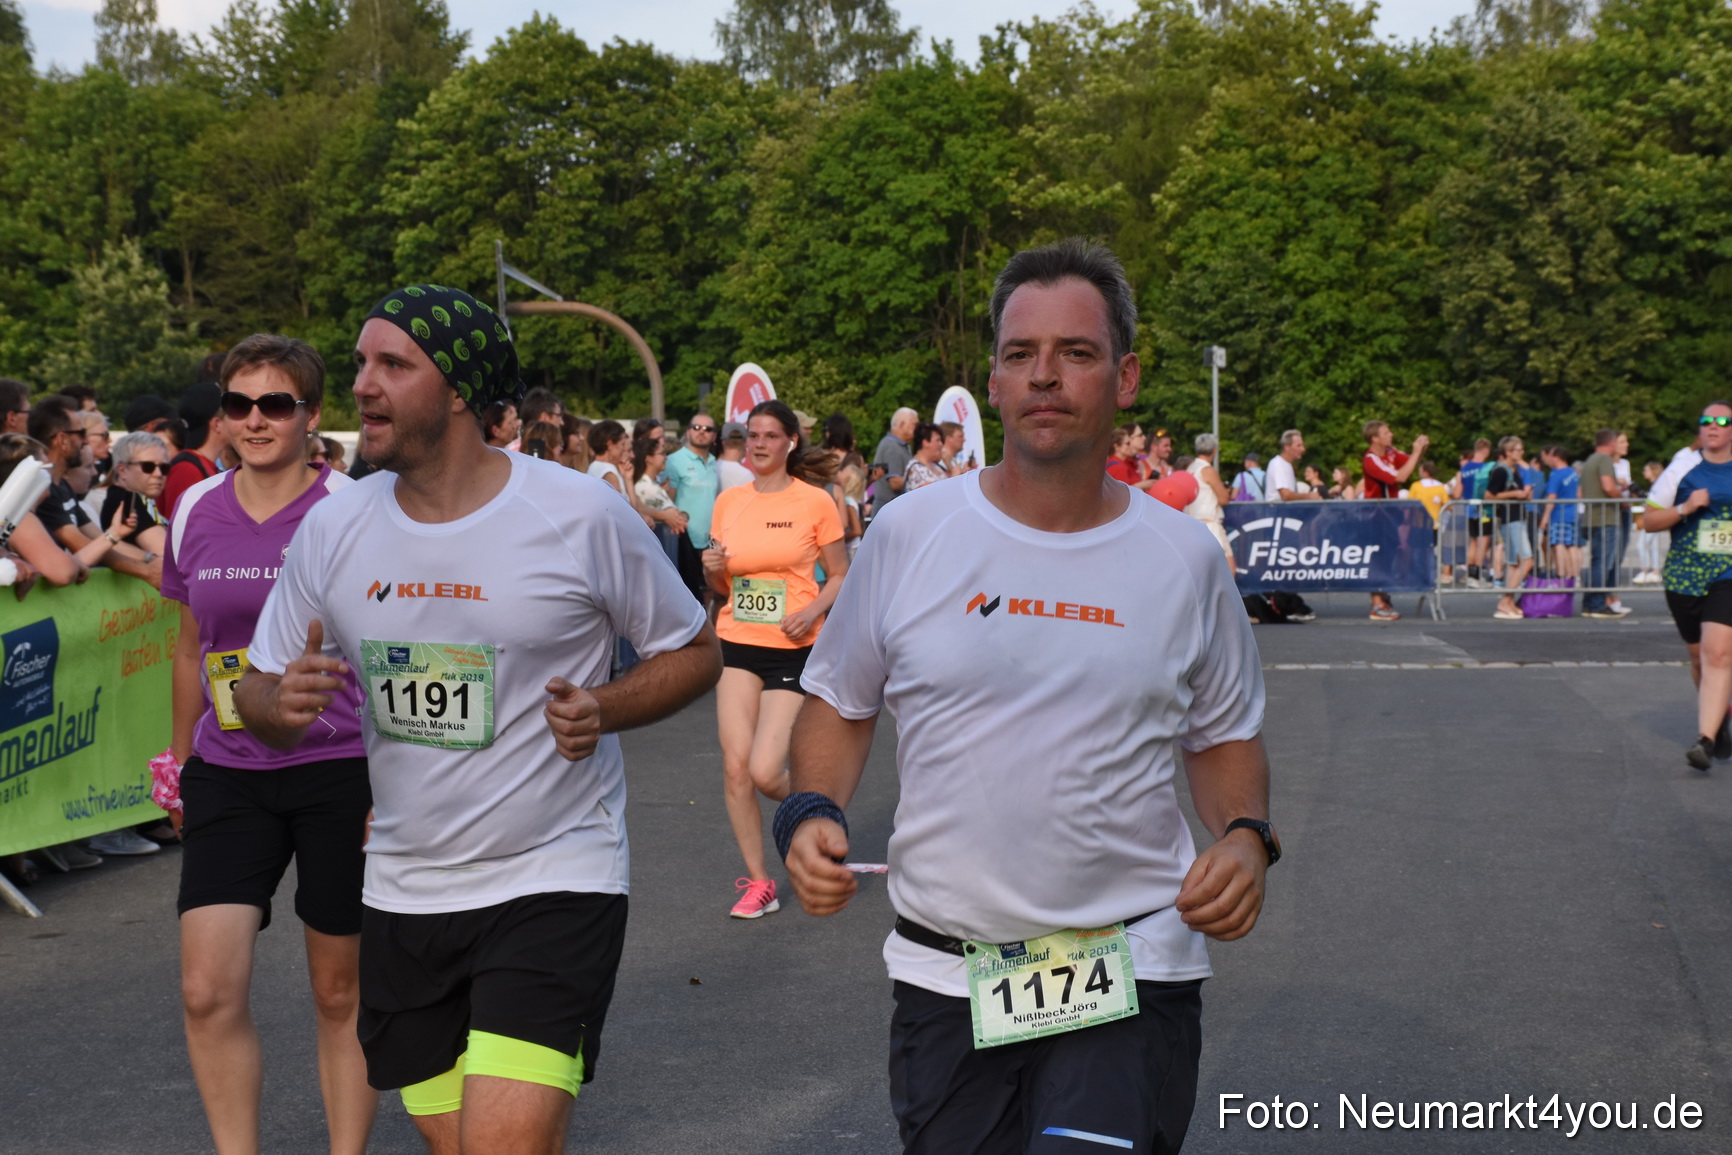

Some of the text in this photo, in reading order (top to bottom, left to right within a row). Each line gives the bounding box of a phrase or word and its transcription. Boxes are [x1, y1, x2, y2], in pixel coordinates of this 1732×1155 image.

[766, 521, 793, 529] THULE
[1248, 538, 1381, 567] Fischer
[198, 568, 221, 581] WIR
[225, 567, 261, 580] SIND
[1260, 567, 1370, 582] AUTOMOBILE
[397, 583, 488, 601] KLEBL
[737, 593, 777, 612] 2303
[1008, 598, 1125, 628] KLEBL
[11, 653, 52, 680] Fischer
[380, 662, 430, 674] firmenlauf
[460, 673, 485, 682] 2019
[380, 678, 469, 720] 1191
[389, 715, 466, 731] Wenisch Markus
[407, 728, 445, 738] Klebl GmbH
[991, 947, 1051, 971] firmenlauf
[1089, 943, 1118, 959] 2019
[991, 957, 1114, 1015] 1174
[1013, 1001, 1098, 1024] Nißlbeck Jörg
[1031, 1019, 1054, 1029] Klebl
[1055, 1014, 1081, 1025] GmbH
